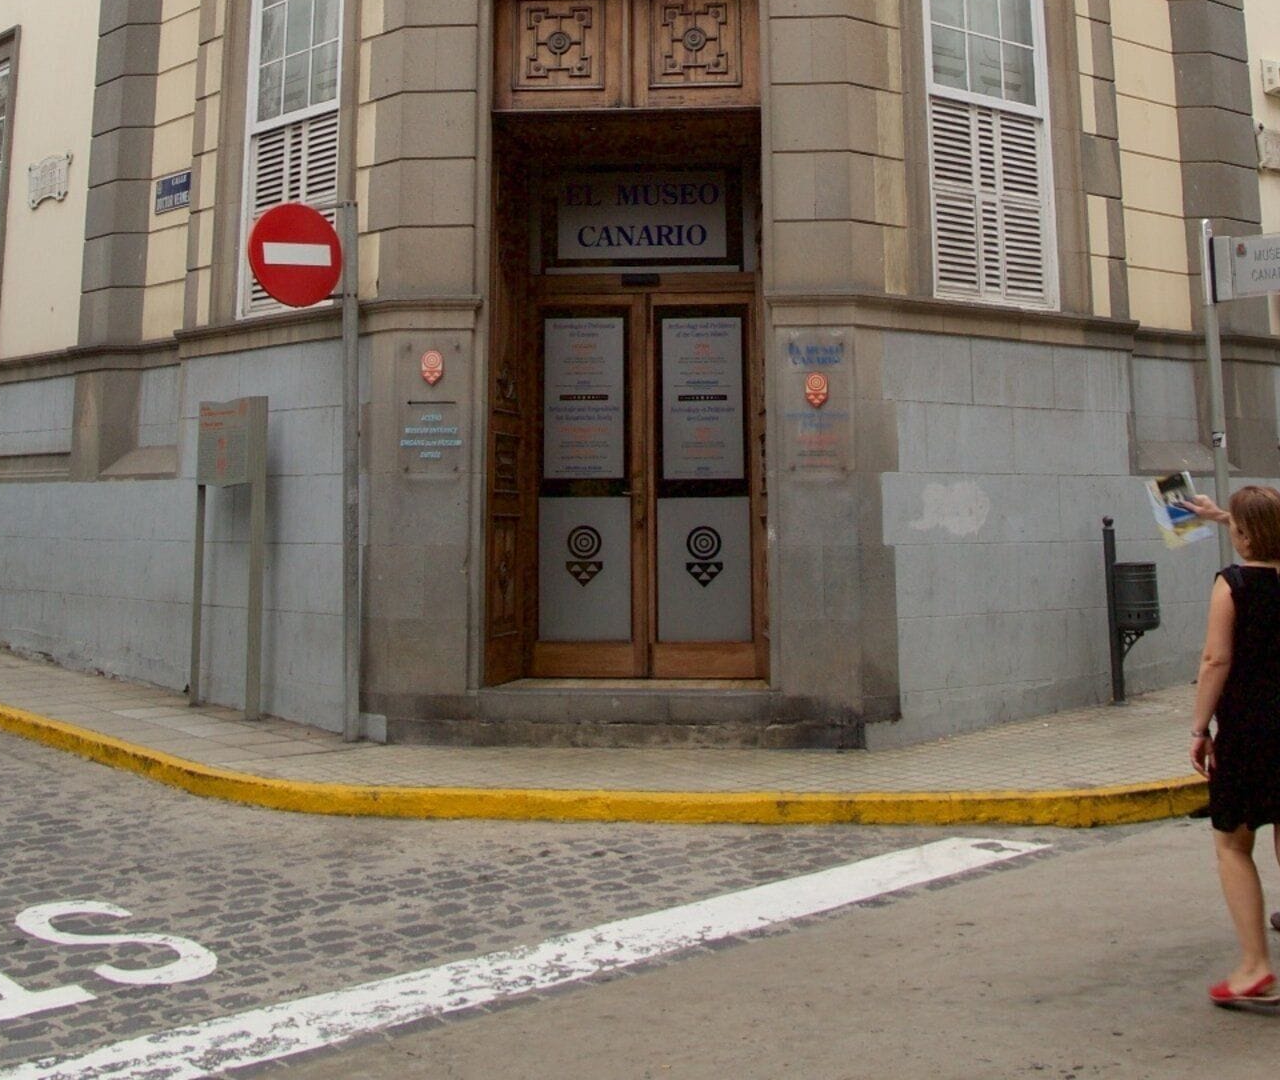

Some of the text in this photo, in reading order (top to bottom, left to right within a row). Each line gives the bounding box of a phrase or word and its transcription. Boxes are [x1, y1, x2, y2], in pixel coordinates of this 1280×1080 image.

[566, 182, 720, 206] EL MUSEO
[577, 224, 707, 247] CANARIO
